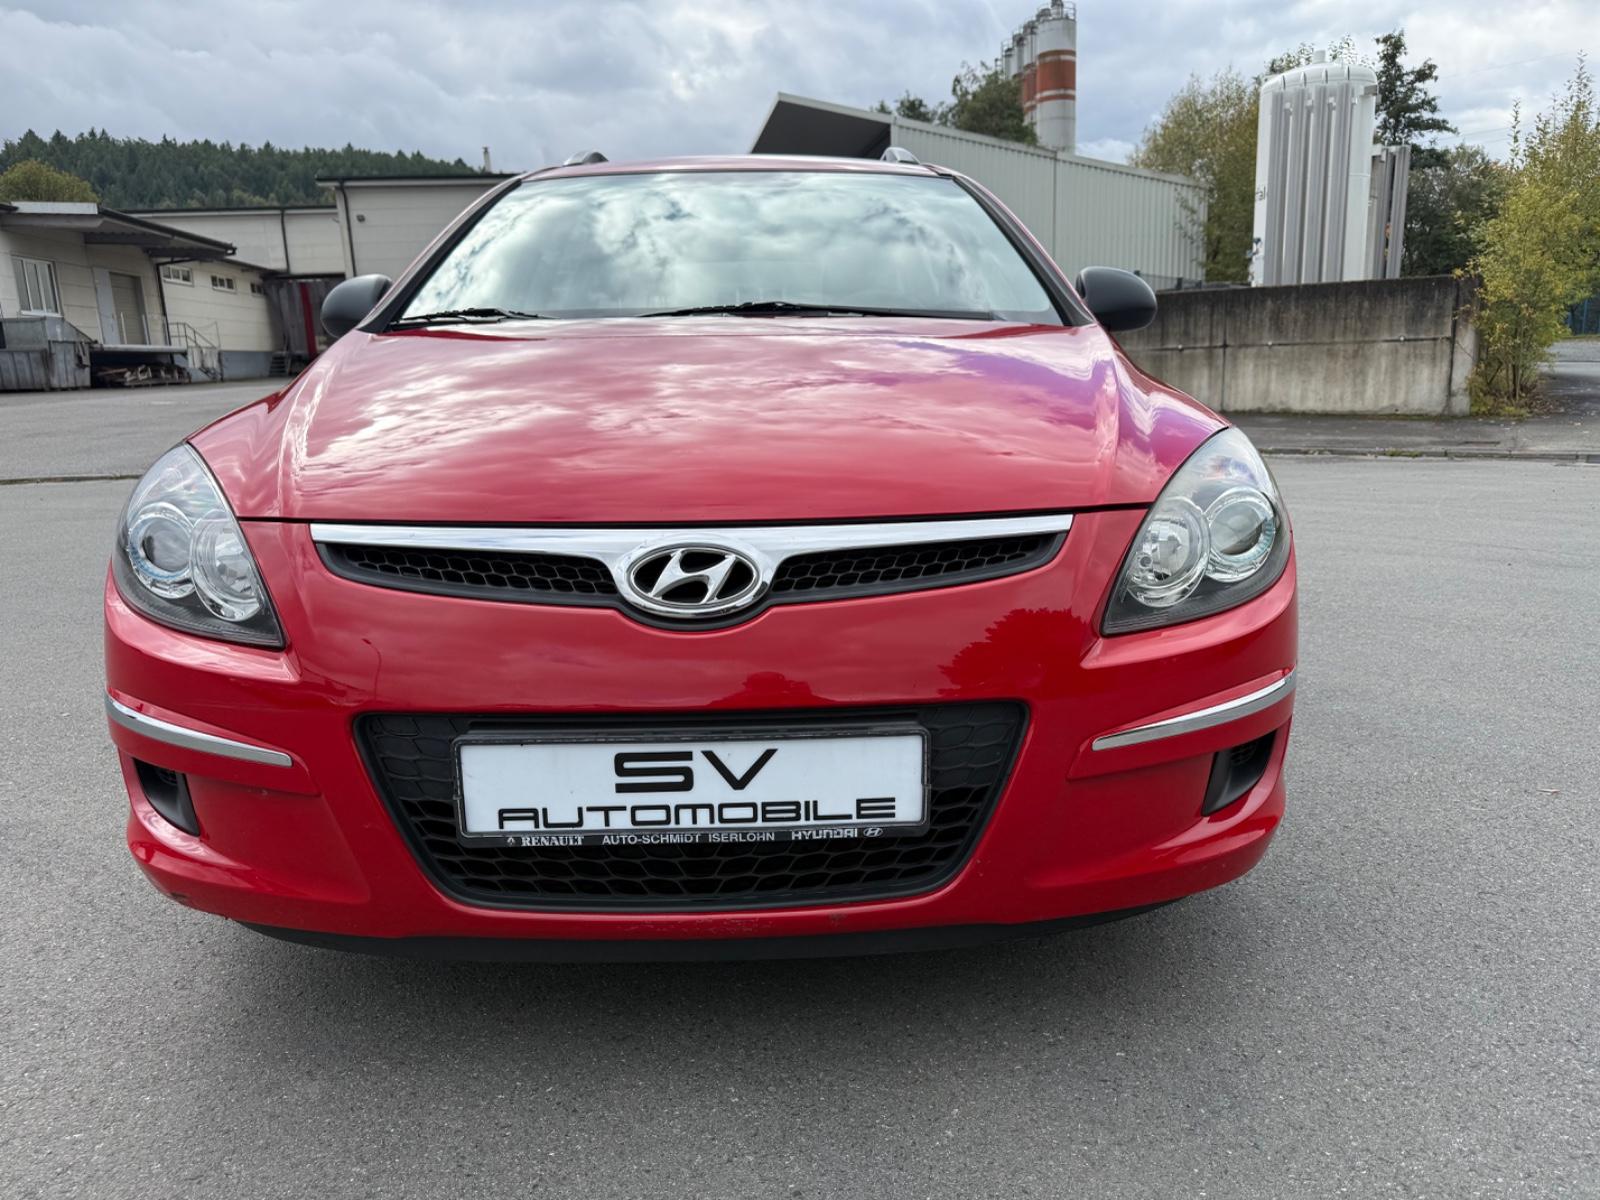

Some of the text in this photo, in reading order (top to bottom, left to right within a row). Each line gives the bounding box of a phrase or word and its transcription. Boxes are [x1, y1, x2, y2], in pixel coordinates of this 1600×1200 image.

[614, 748, 777, 793] SV
[498, 797, 896, 829] AUTOMOBILE
[521, 828, 858, 847] RENAULT AUTO-SCHMIDT ISERLOHN HYUNDAI
